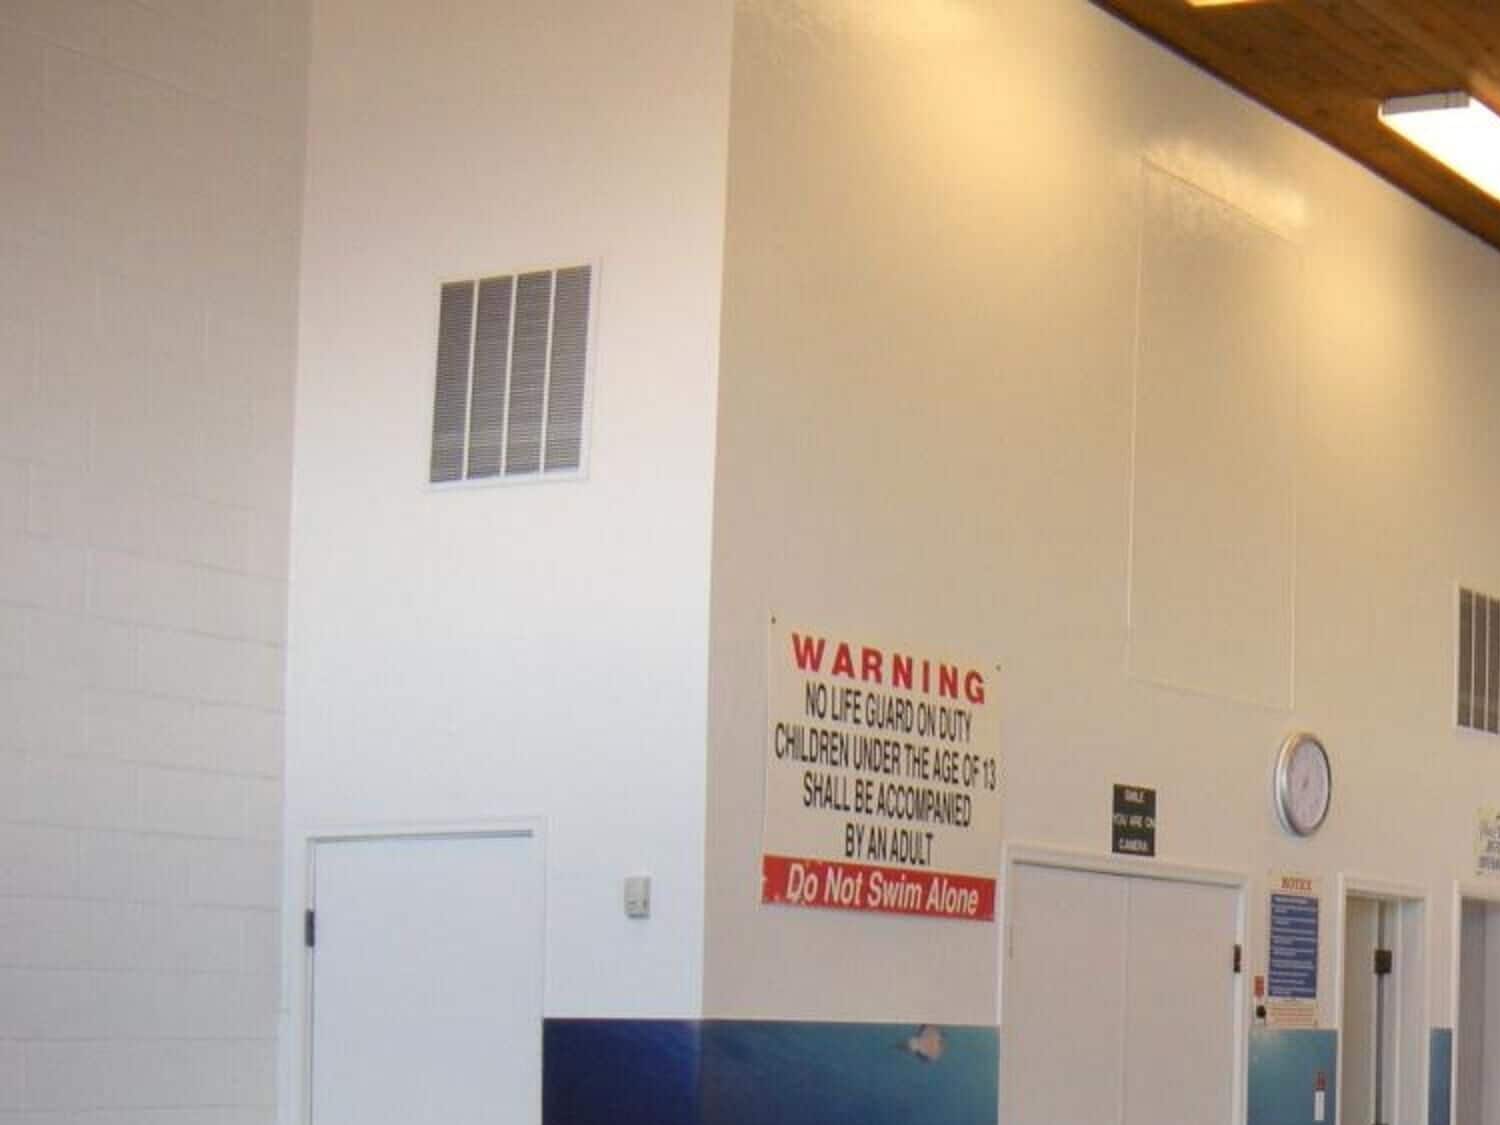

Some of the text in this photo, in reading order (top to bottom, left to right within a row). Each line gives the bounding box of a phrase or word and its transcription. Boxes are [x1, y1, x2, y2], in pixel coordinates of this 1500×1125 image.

[792, 632, 985, 704] WARNING
[805, 681, 972, 745] NO LIFE GUARD ON DUTY
[775, 722, 996, 791] CHILDREN UNDER THE AGE OF 13
[803, 770, 971, 828] SHALL BE ACCOMPANIED
[845, 823, 933, 866] BY AN ADULT
[786, 863, 978, 915] Do Not Swim Alone
[1281, 876, 1313, 891] NOTICE
